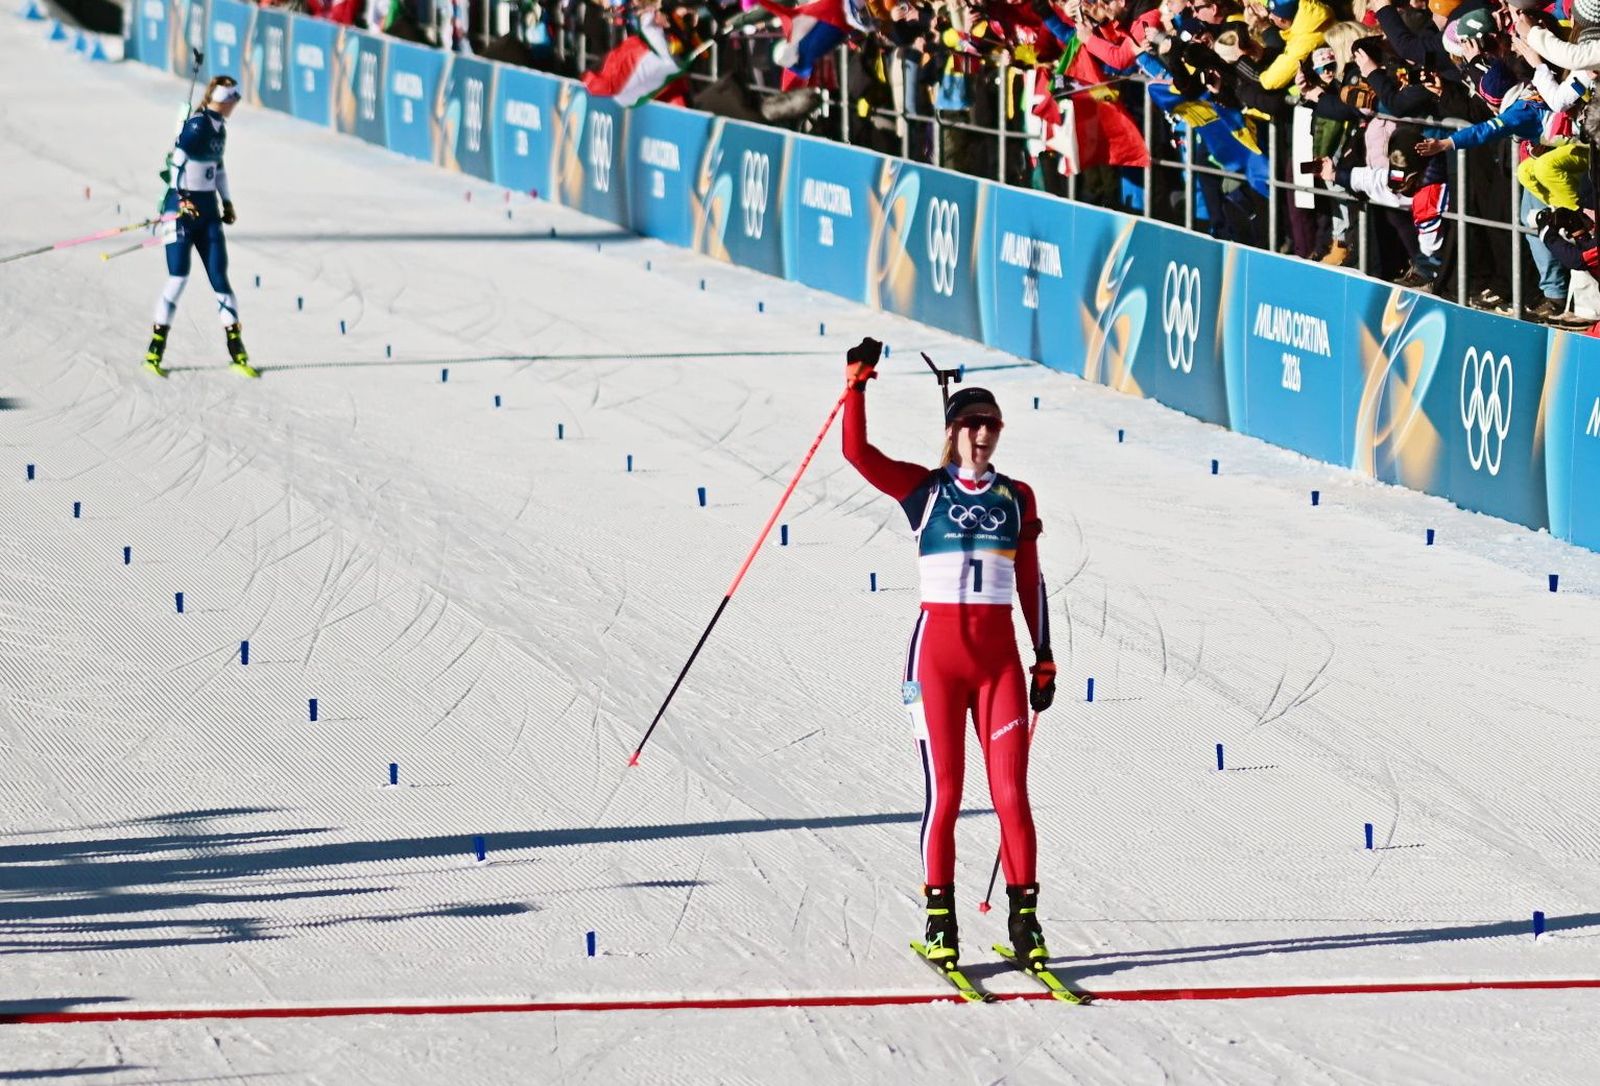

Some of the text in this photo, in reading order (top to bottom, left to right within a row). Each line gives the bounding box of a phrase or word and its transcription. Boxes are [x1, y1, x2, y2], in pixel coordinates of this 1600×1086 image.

[1253, 302, 1332, 358] MILANO CORTINA
[1281, 352, 1302, 393] 2026
[969, 558, 983, 592] 1
[991, 719, 1019, 741] CRAFT
